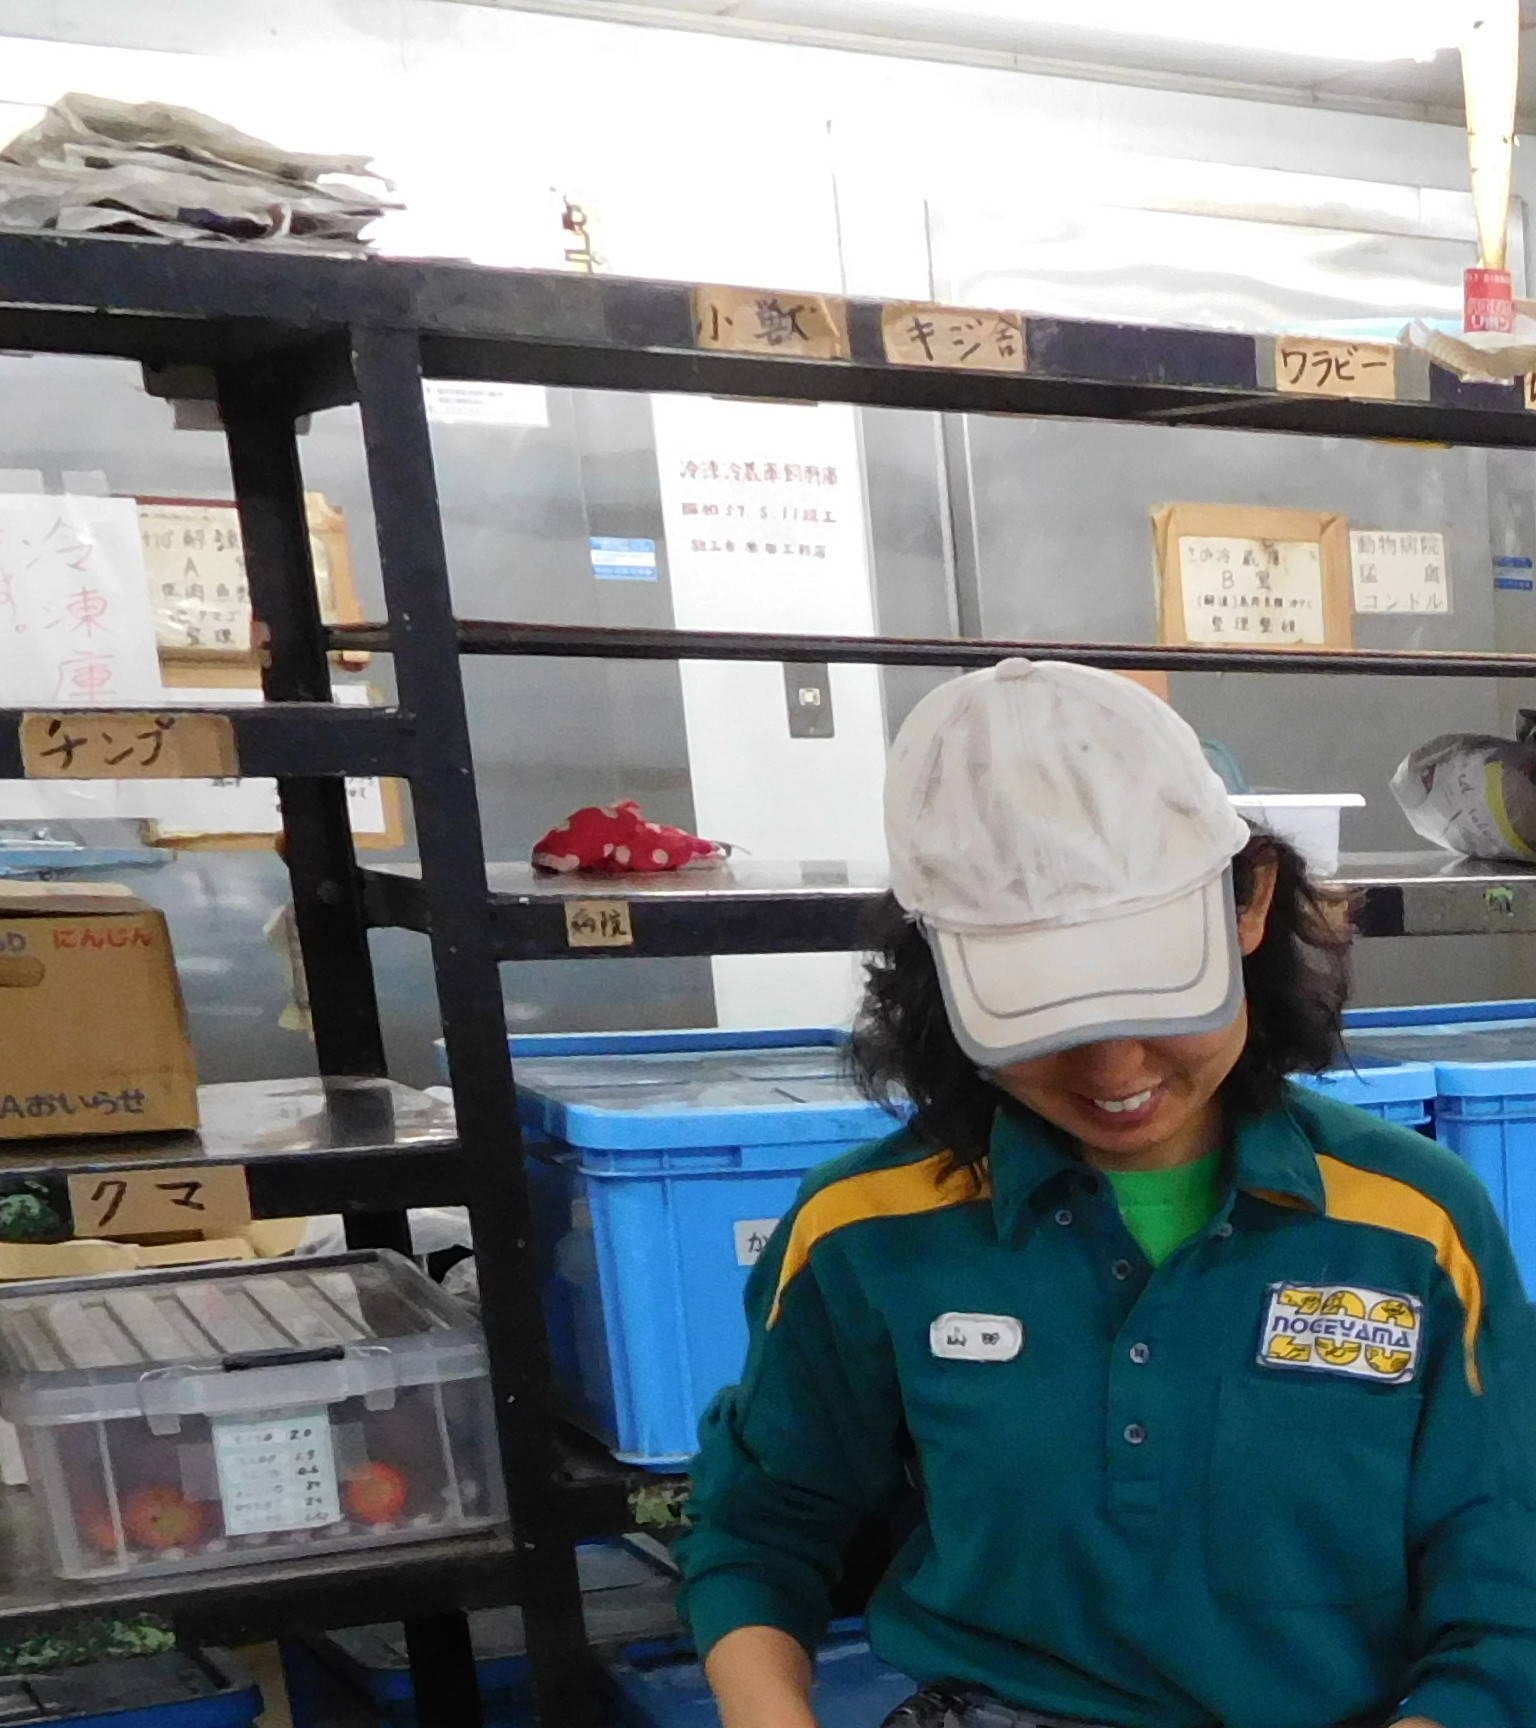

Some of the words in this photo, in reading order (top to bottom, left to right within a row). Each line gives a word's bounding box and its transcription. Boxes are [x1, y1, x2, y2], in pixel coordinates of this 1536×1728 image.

[1282, 346, 1388, 387] ワラビー
[53, 928, 153, 949] にんじん
[91, 1181, 206, 1228] クマ
